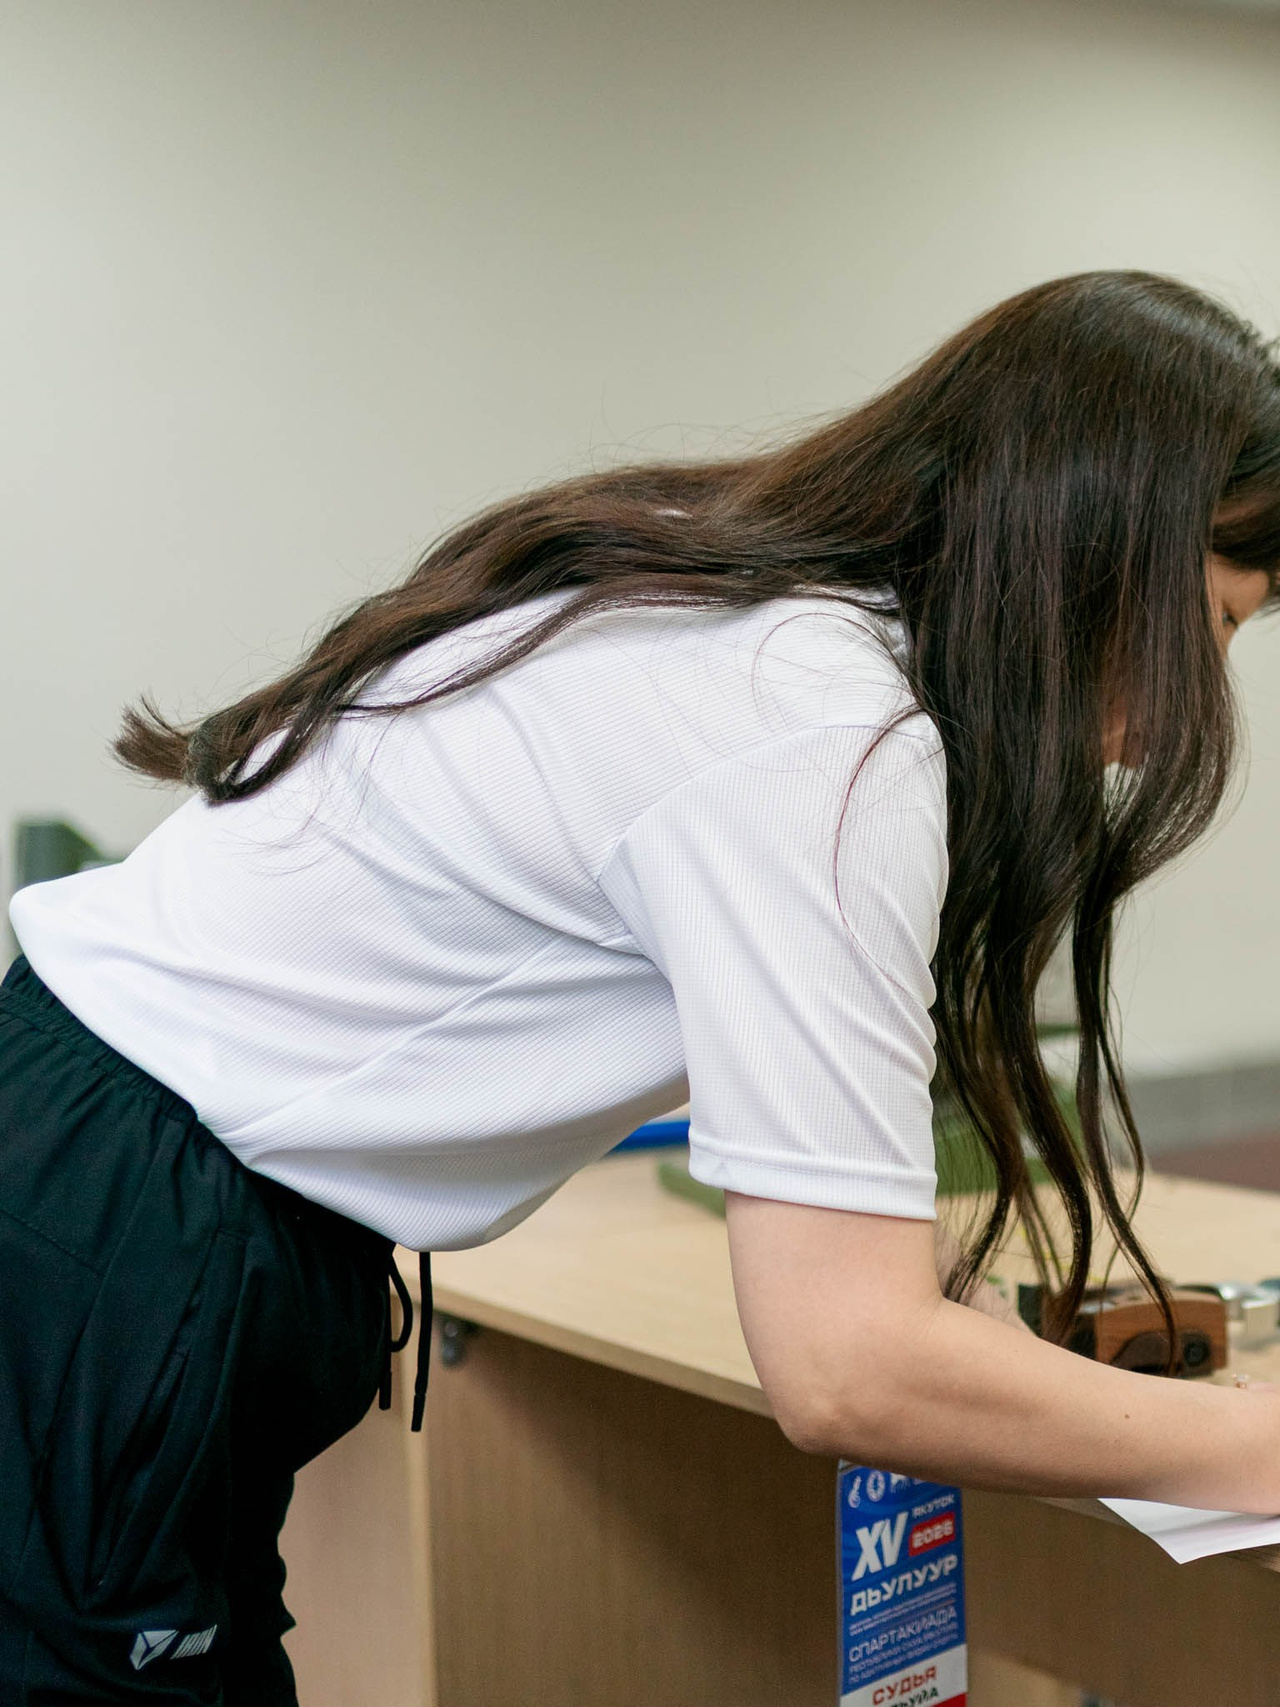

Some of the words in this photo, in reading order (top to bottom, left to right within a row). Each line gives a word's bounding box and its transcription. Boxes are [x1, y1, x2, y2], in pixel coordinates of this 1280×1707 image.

[851, 1511, 909, 1580] XV
[850, 1554, 958, 1616] ДЬУЛУУР
[849, 1605, 958, 1662] СПАРТАКИАДА
[872, 1666, 937, 1706] СУДЬЯ
